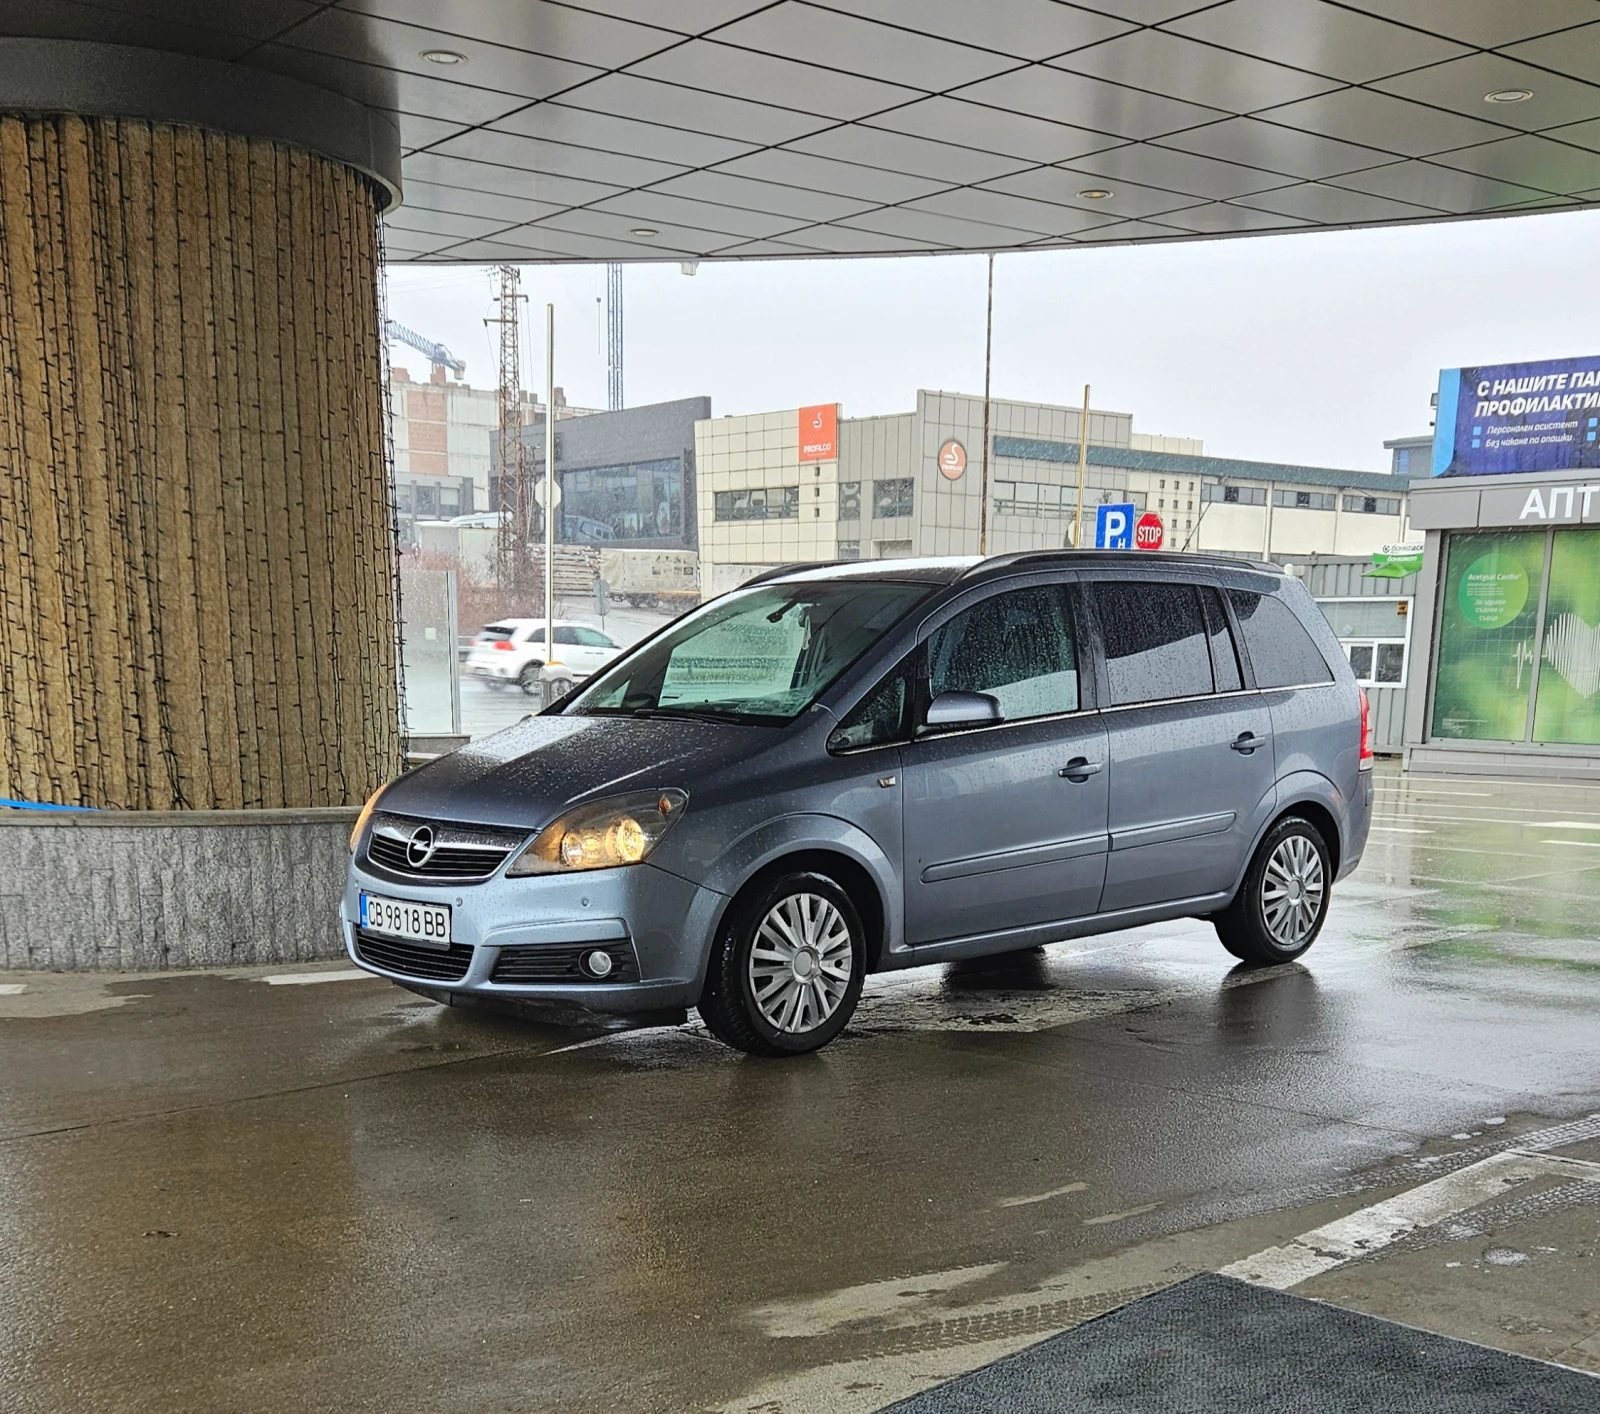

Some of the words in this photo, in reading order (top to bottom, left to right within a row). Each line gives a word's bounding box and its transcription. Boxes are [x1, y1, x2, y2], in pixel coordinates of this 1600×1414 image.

[1477, 381, 1490, 397] С
[1492, 373, 1569, 396] НАШИТЕ
[1487, 423, 1534, 436] Персонален
[1500, 437, 1528, 446] чакане
[1529, 436, 1539, 444] по
[1518, 485, 1600, 520] АПТ
[1104, 511, 1126, 549] P
[1137, 525, 1162, 543] STOP
